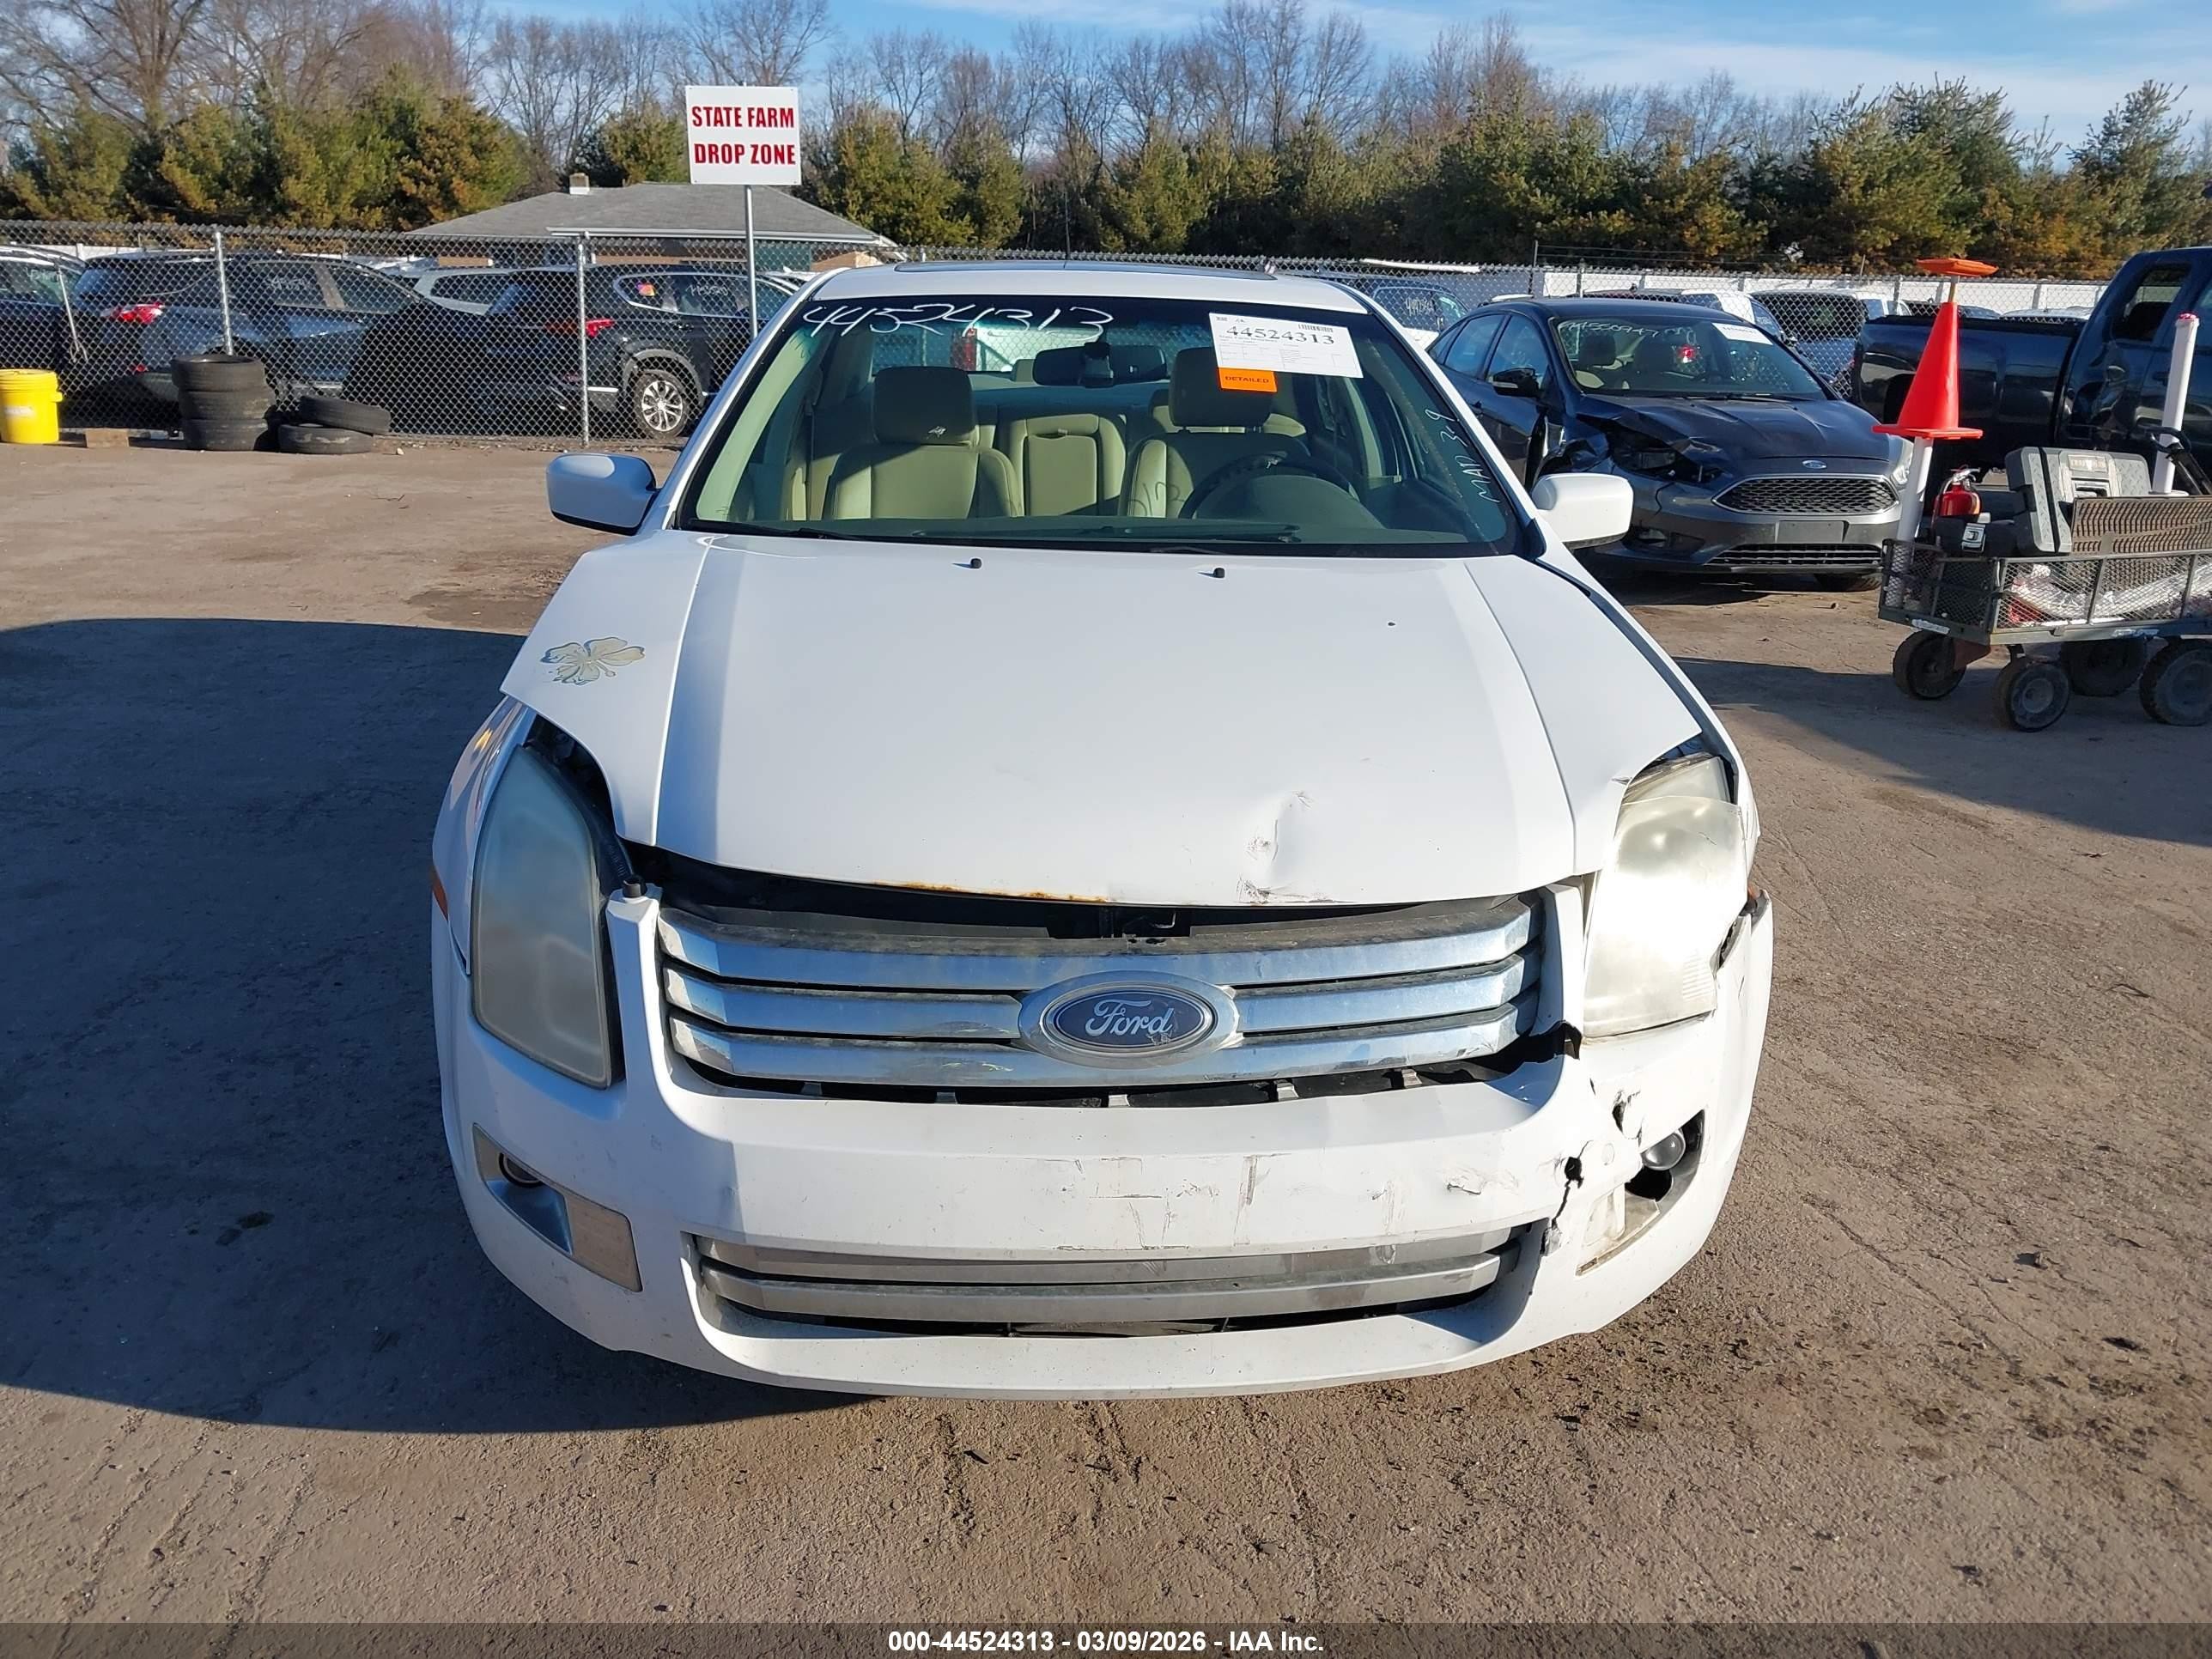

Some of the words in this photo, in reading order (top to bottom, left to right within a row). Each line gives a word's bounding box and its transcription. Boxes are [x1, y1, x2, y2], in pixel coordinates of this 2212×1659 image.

[691, 106, 743, 127] STATE
[747, 106, 794, 128] FARM
[694, 143, 745, 164] DROP
[750, 144, 796, 165] ZONE
[802, 303, 1115, 341] 44524313
[1226, 325, 1334, 345] 44524313
[1224, 375, 1270, 384] DETAILED
[1085, 999, 1176, 1036] Ford
